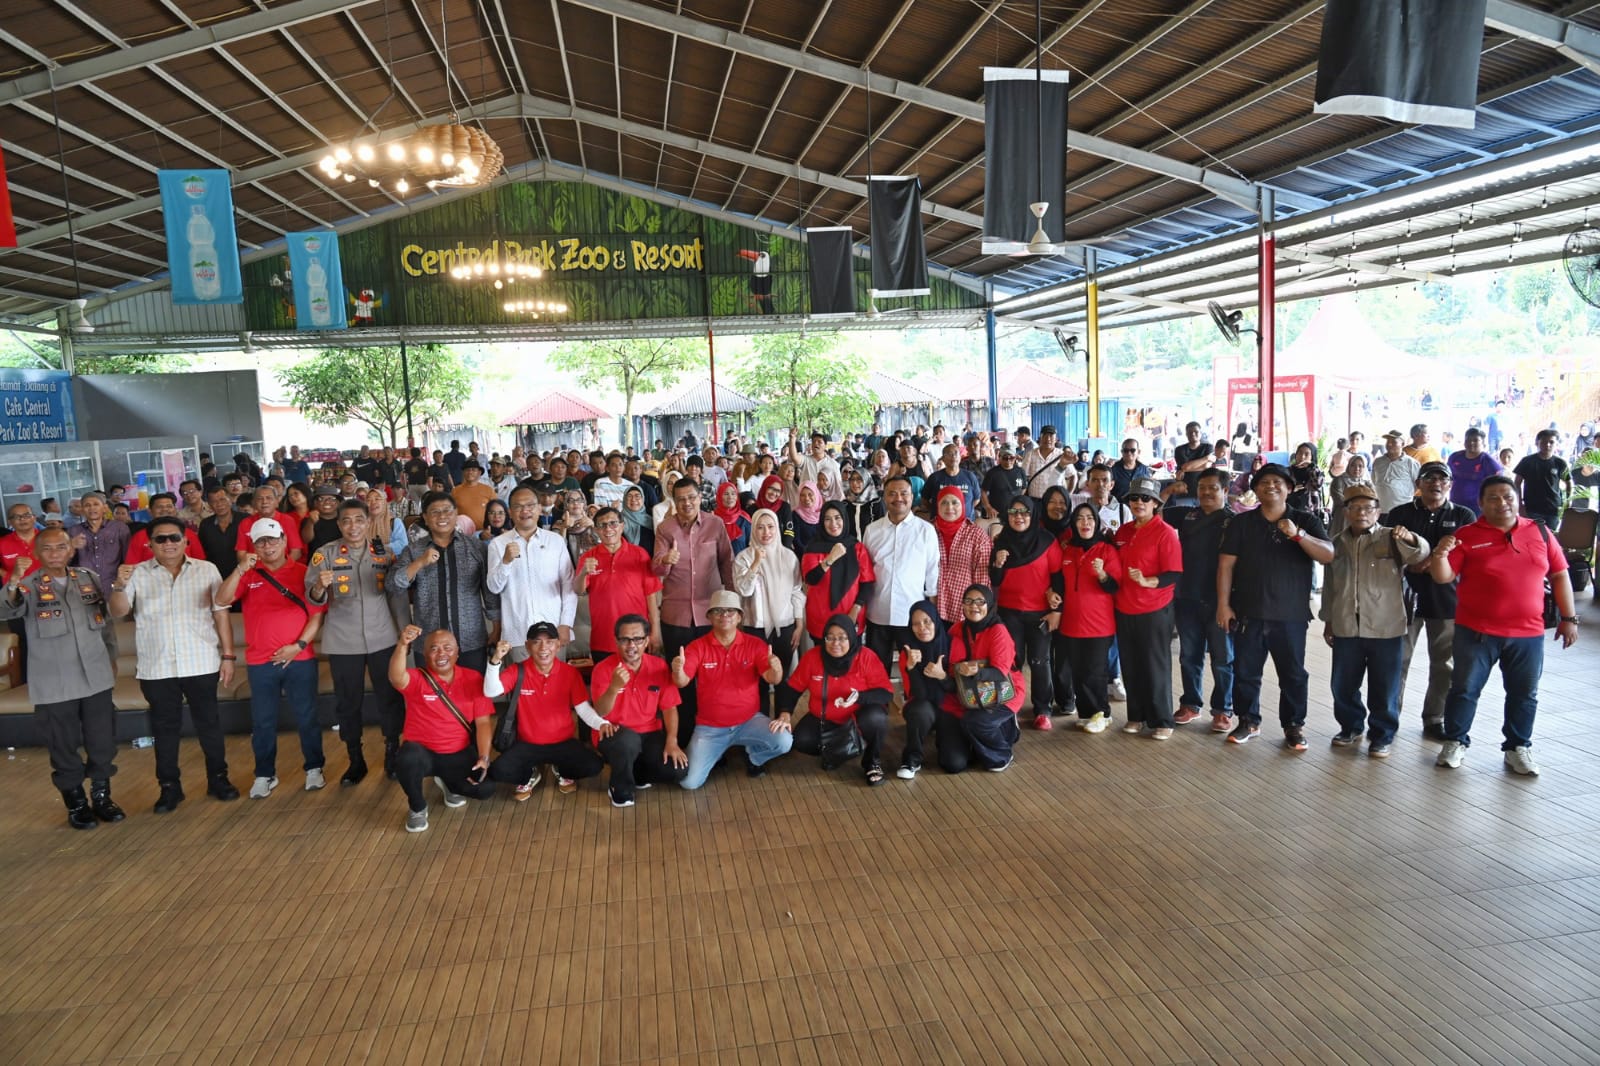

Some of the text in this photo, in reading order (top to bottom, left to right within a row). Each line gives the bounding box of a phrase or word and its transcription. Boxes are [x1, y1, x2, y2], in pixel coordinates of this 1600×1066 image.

[401, 237, 704, 276] Central Park Zoo & Resort
[5, 397, 50, 416] Cafe Central
[17, 422, 30, 440] Zoo
[33, 421, 39, 440] &
[41, 421, 62, 439] Resort
